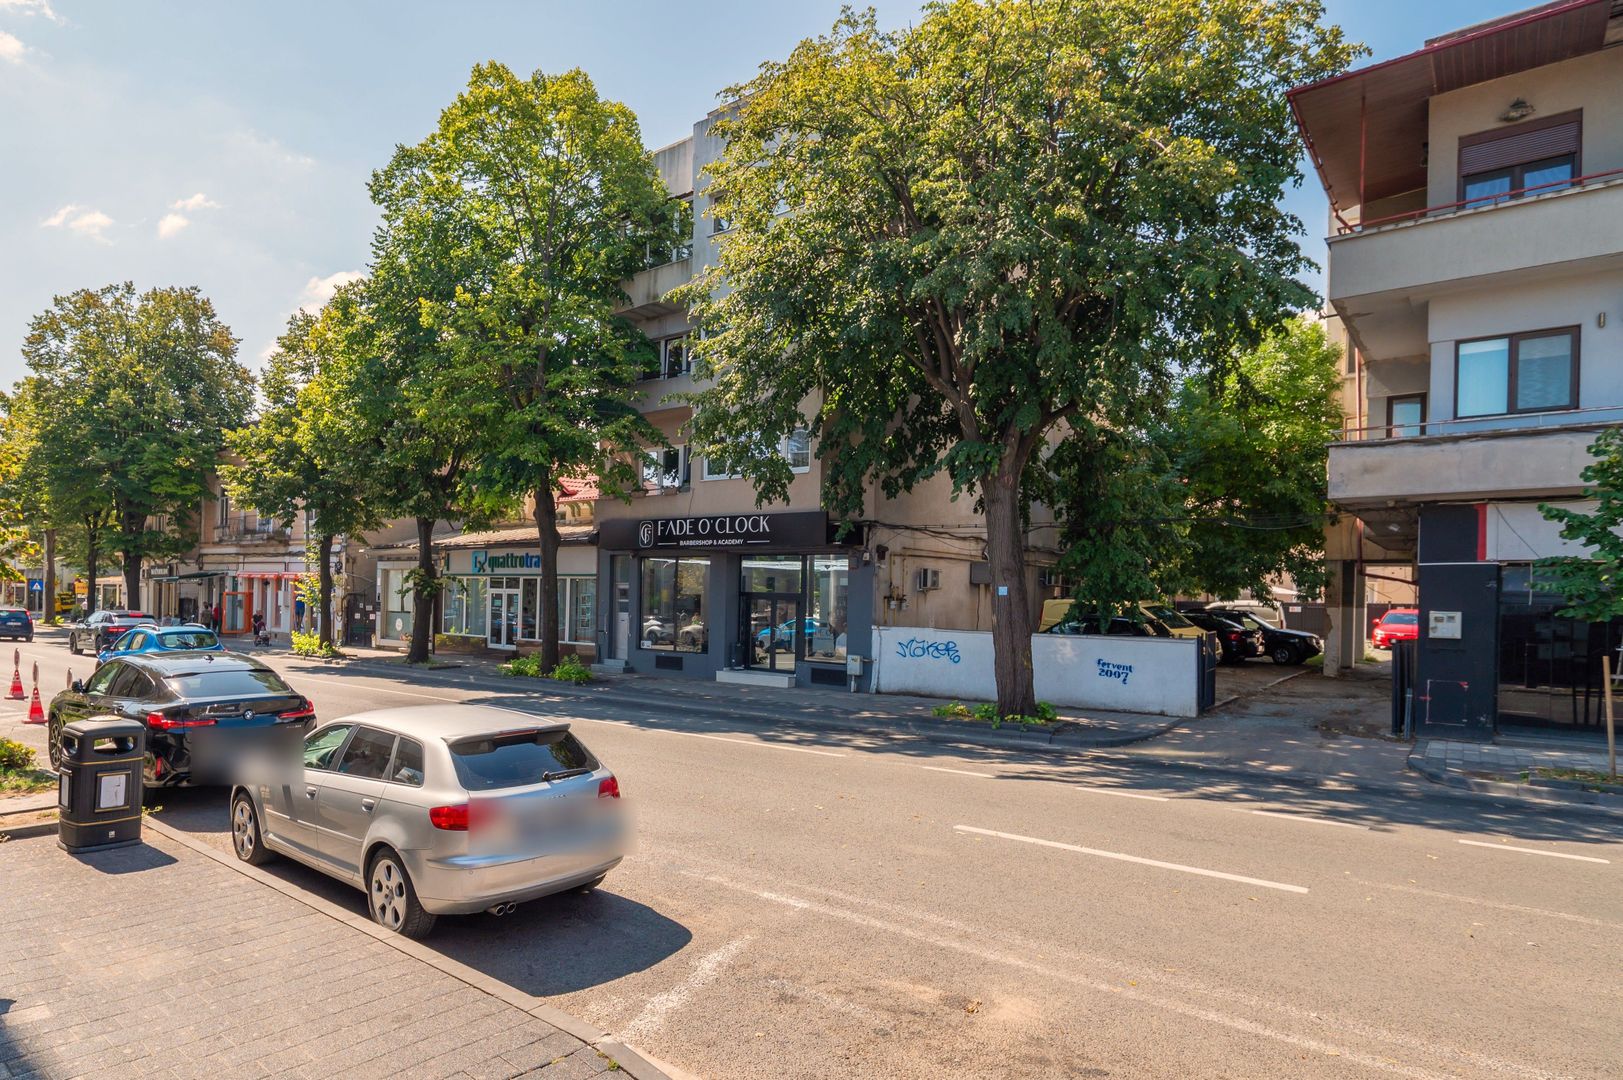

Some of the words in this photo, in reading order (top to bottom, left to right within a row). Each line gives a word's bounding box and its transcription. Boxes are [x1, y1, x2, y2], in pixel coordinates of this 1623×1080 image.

[657, 519, 695, 536] FADE
[698, 515, 770, 534] O'CLOCK
[488, 552, 542, 573] quattrotra
[1098, 668, 1129, 685] 2007
